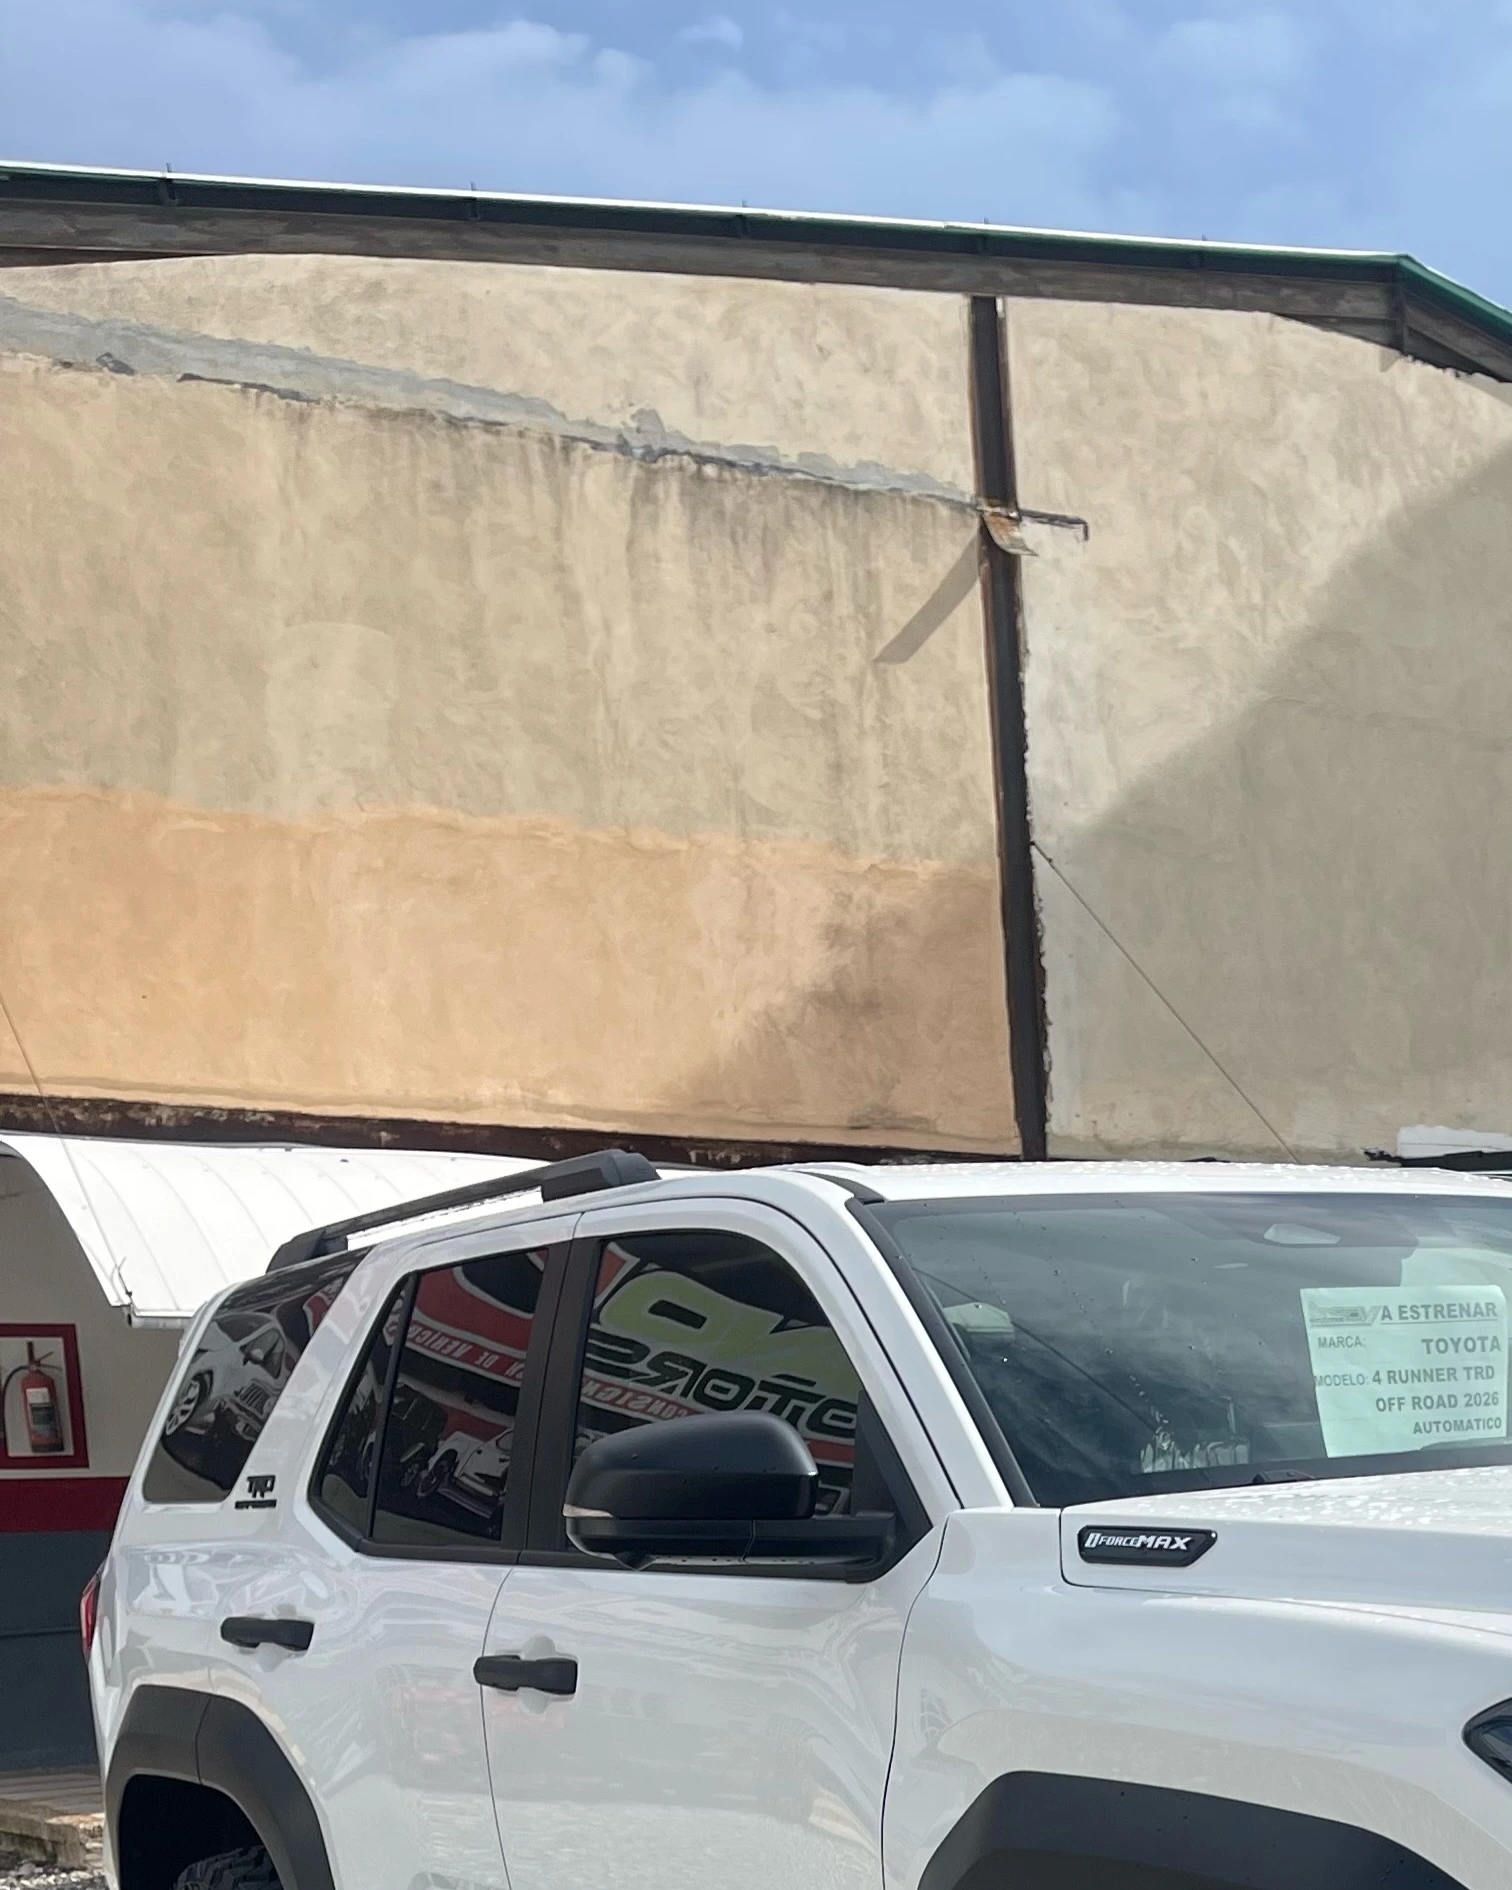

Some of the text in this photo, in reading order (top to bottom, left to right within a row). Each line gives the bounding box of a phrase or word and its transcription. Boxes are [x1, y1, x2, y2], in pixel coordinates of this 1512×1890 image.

[1380, 1305, 1393, 1321] A
[1398, 1302, 1498, 1320] ESTRENAR
[1317, 1336, 1502, 1354] MARCA: TOYOTA
[1372, 1369, 1382, 1386] 4
[1387, 1366, 1458, 1385] RUNNER
[1464, 1365, 1495, 1381] TRD
[1375, 1391, 1499, 1412] OFF ROAD 2026
[1412, 1417, 1502, 1434] AUTOMATICO
